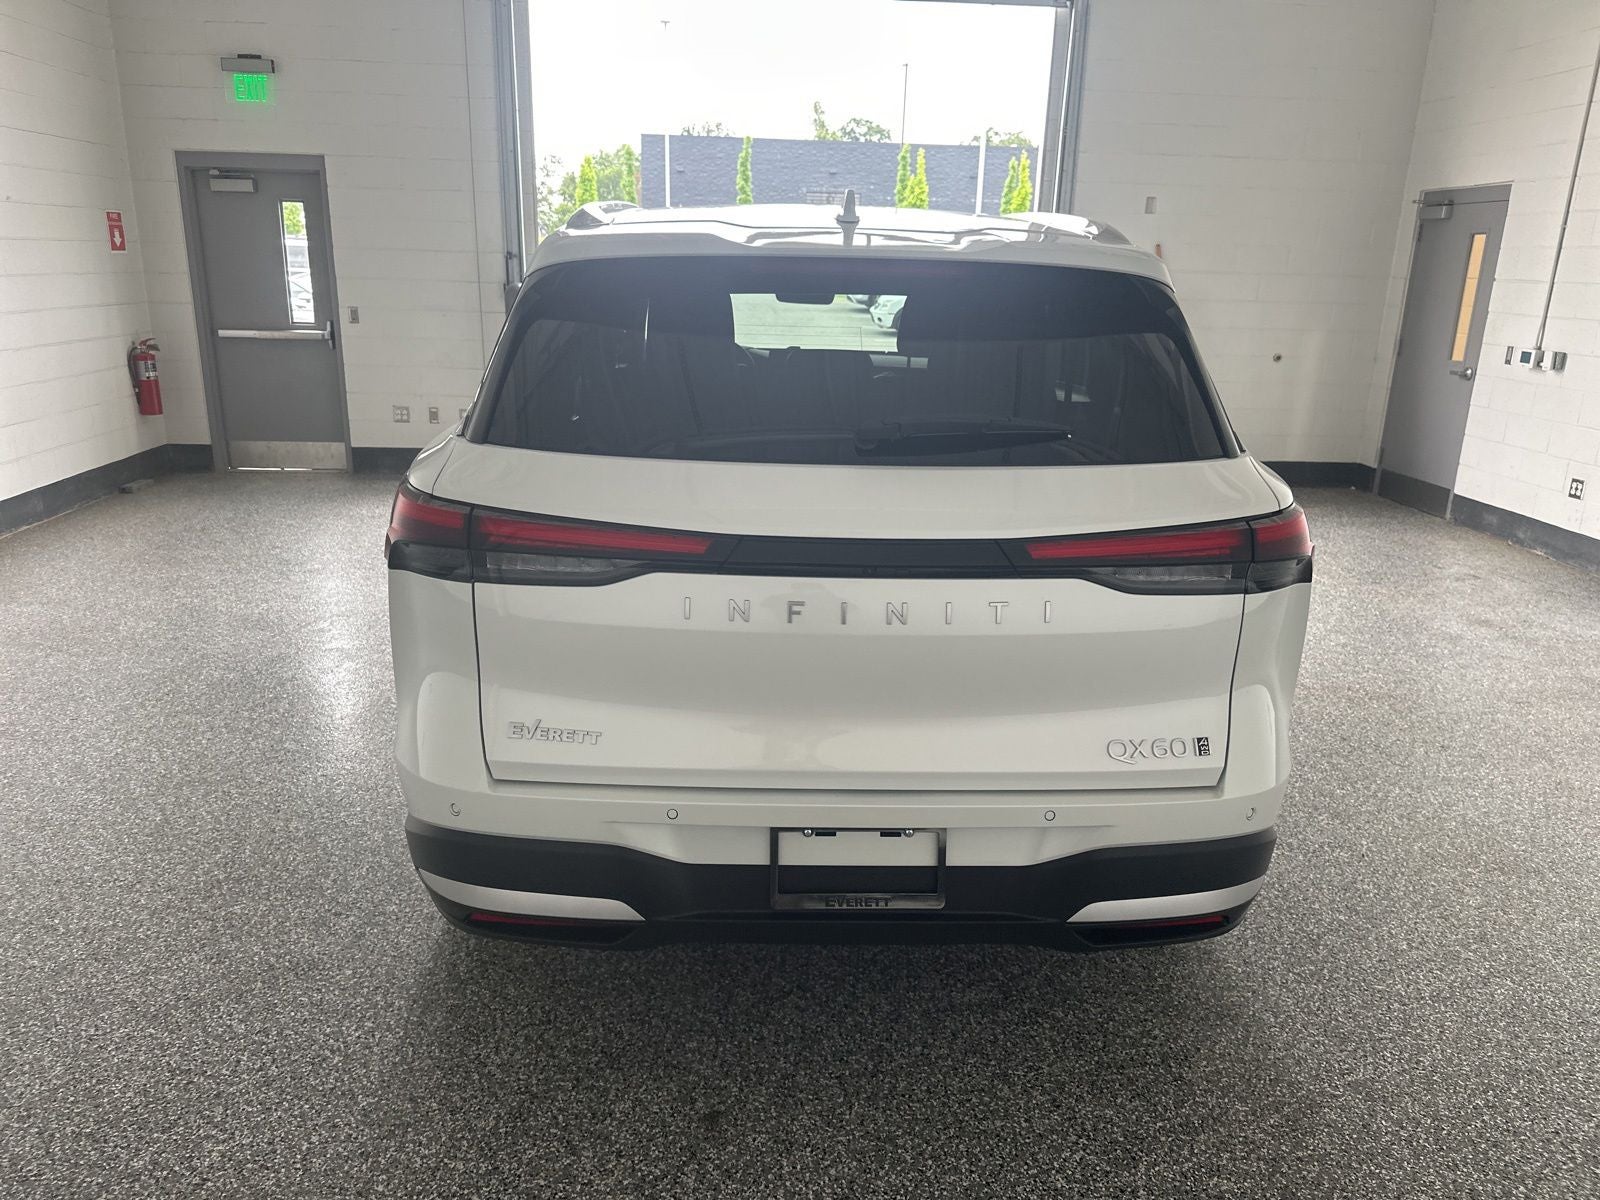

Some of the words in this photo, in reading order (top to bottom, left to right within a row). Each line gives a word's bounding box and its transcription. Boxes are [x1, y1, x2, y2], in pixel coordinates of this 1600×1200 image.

[234, 74, 268, 102] EXIT
[683, 597, 1052, 625] INFINITI
[507, 719, 603, 746] EVERETT
[1106, 738, 1189, 765] QX60
[1197, 737, 1210, 756] AWD
[824, 896, 893, 908] EVERETT
